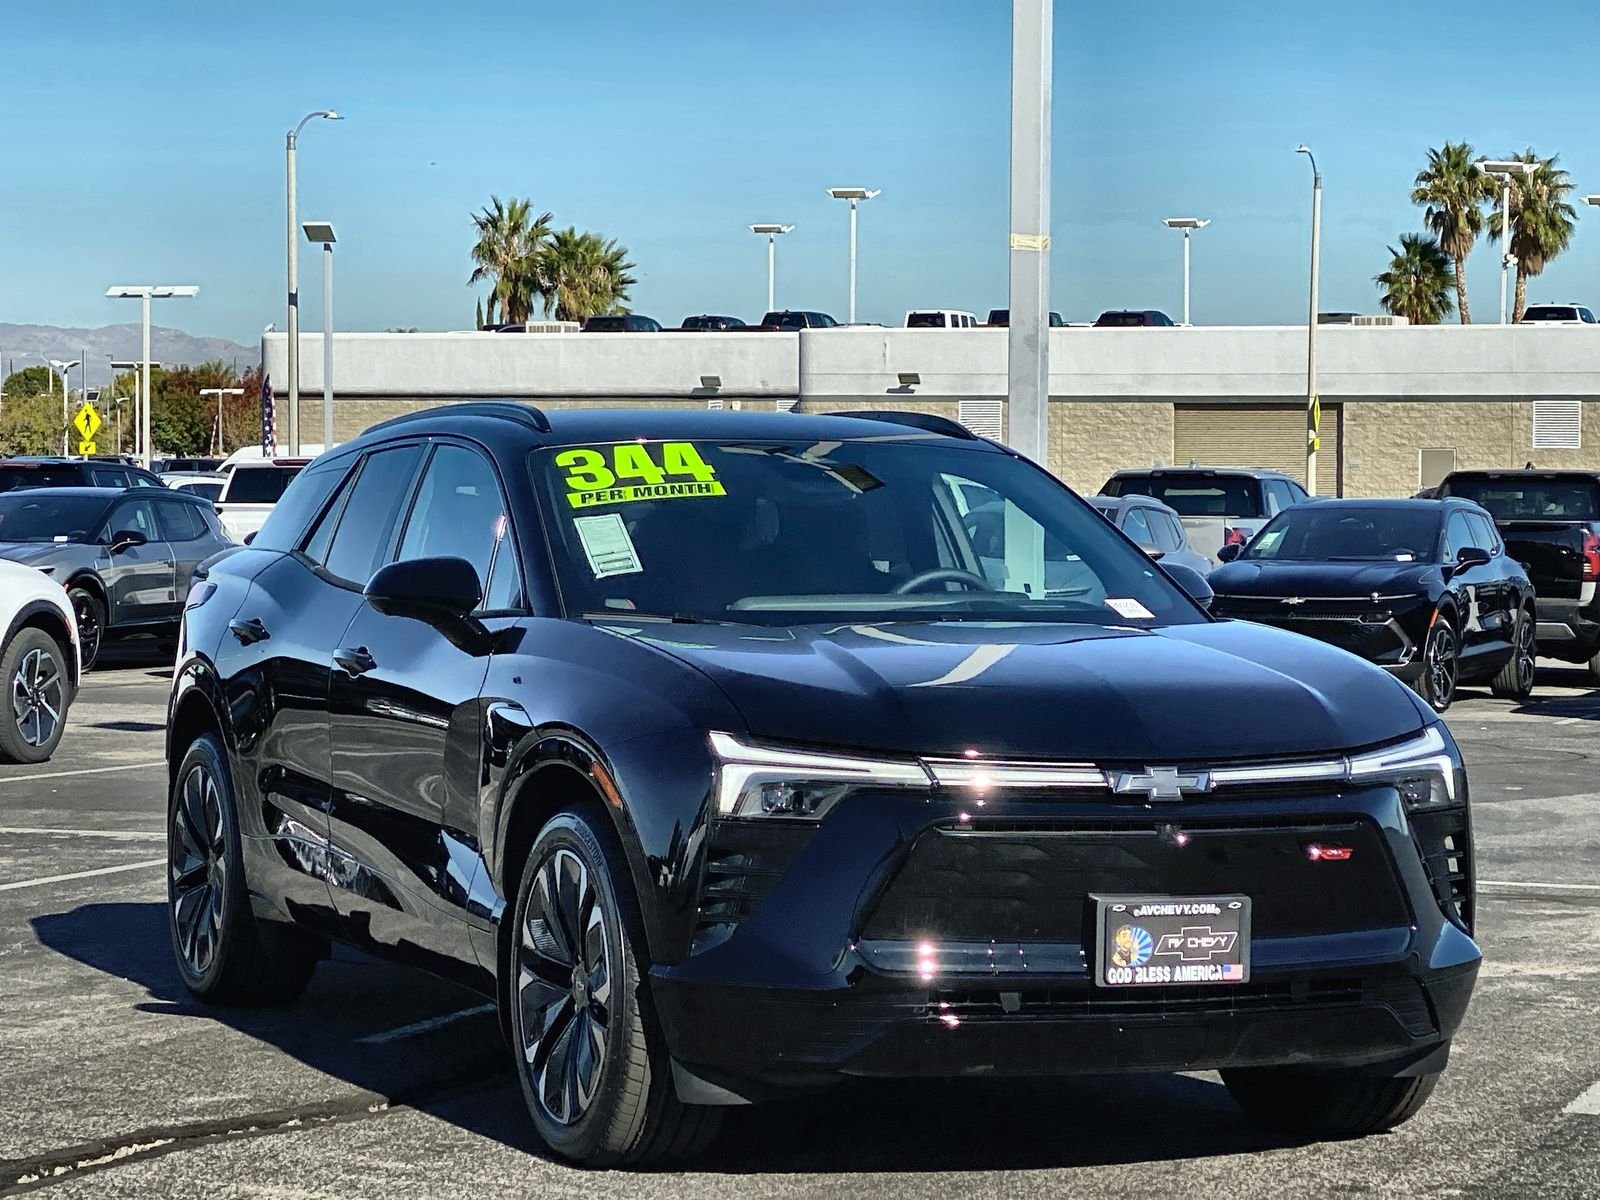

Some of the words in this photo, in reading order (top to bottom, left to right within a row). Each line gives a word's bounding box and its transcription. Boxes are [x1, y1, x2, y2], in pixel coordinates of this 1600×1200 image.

[555, 442, 715, 491] 344
[581, 489, 623, 503] PER
[633, 483, 711, 498] MONTH
[1140, 904, 1216, 916] AVCHEVY.COM
[1108, 967, 1133, 984] GOD
[1135, 965, 1171, 983] BLESS
[1173, 964, 1223, 981] AMERICA
